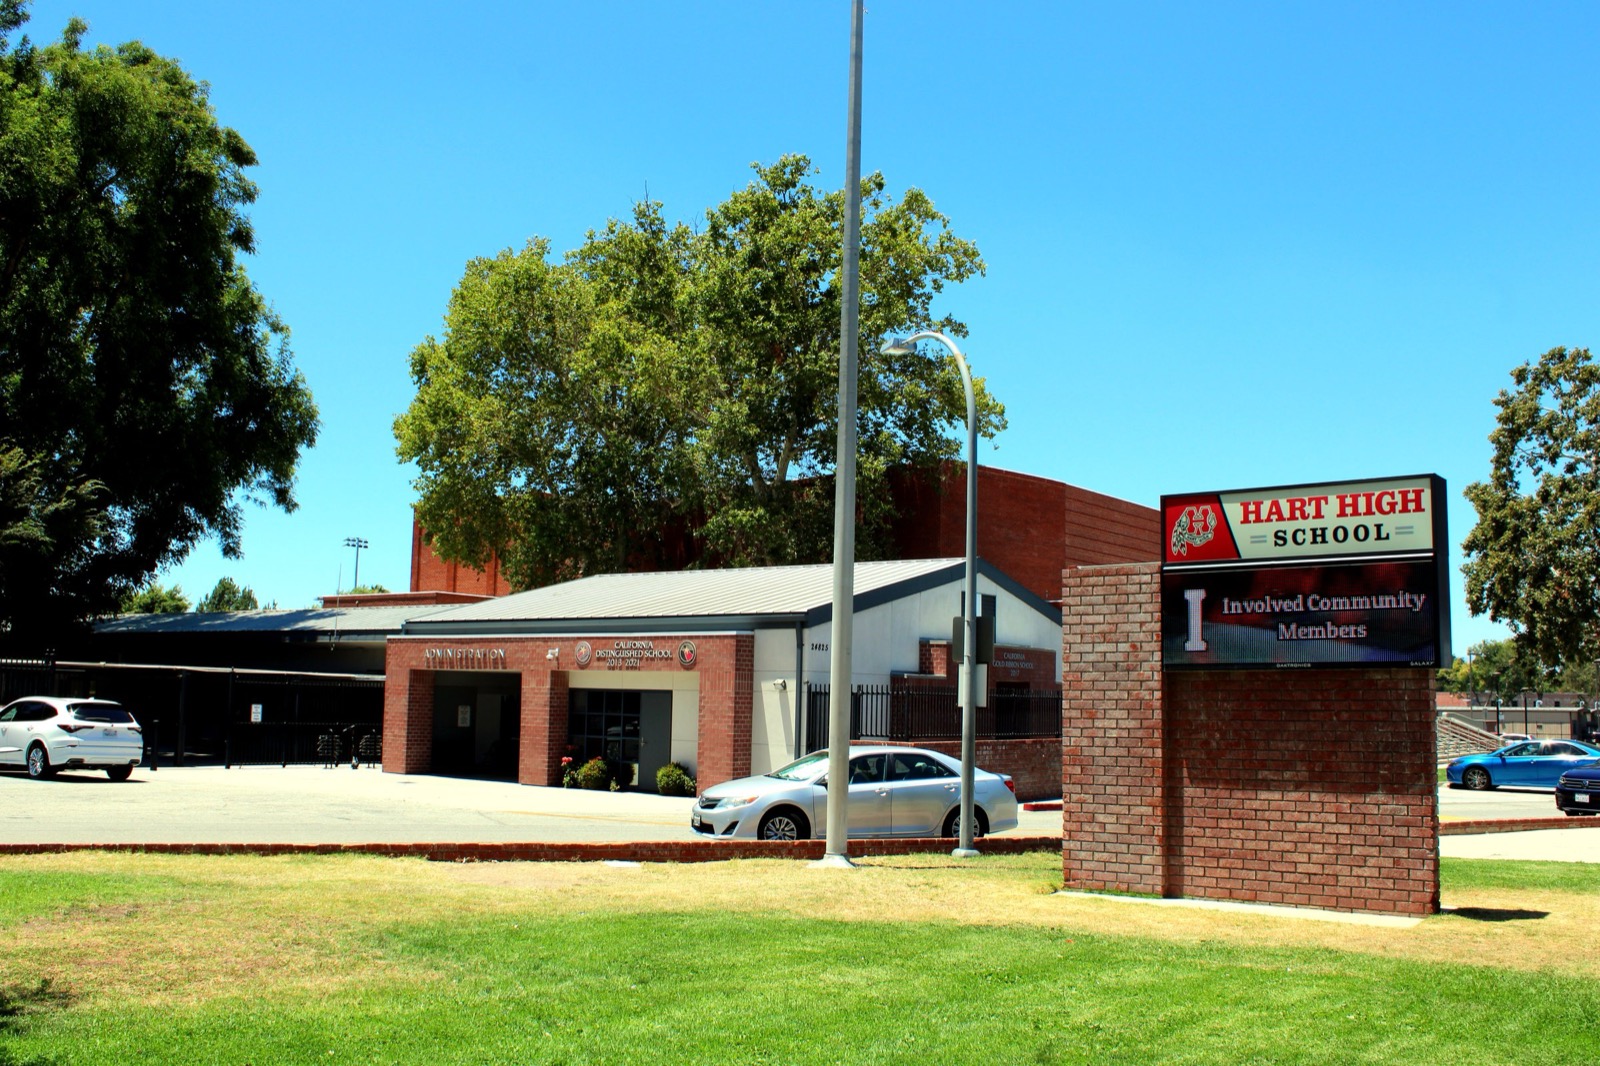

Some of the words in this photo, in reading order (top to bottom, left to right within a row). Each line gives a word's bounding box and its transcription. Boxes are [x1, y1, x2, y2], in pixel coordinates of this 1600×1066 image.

[1240, 496, 1328, 524] HART
[1336, 488, 1425, 518] HIGH
[1274, 523, 1390, 547] SCHOOL
[1222, 594, 1304, 614] Involved
[1307, 590, 1426, 613] Community
[1184, 589, 1207, 651] I
[1278, 621, 1367, 640] Members
[424, 648, 505, 659] ADMINISTRATION
[595, 649, 643, 658] DISTINGUISHED
[644, 649, 672, 658] SCHOOL
[614, 641, 653, 649] CALIFORNIA
